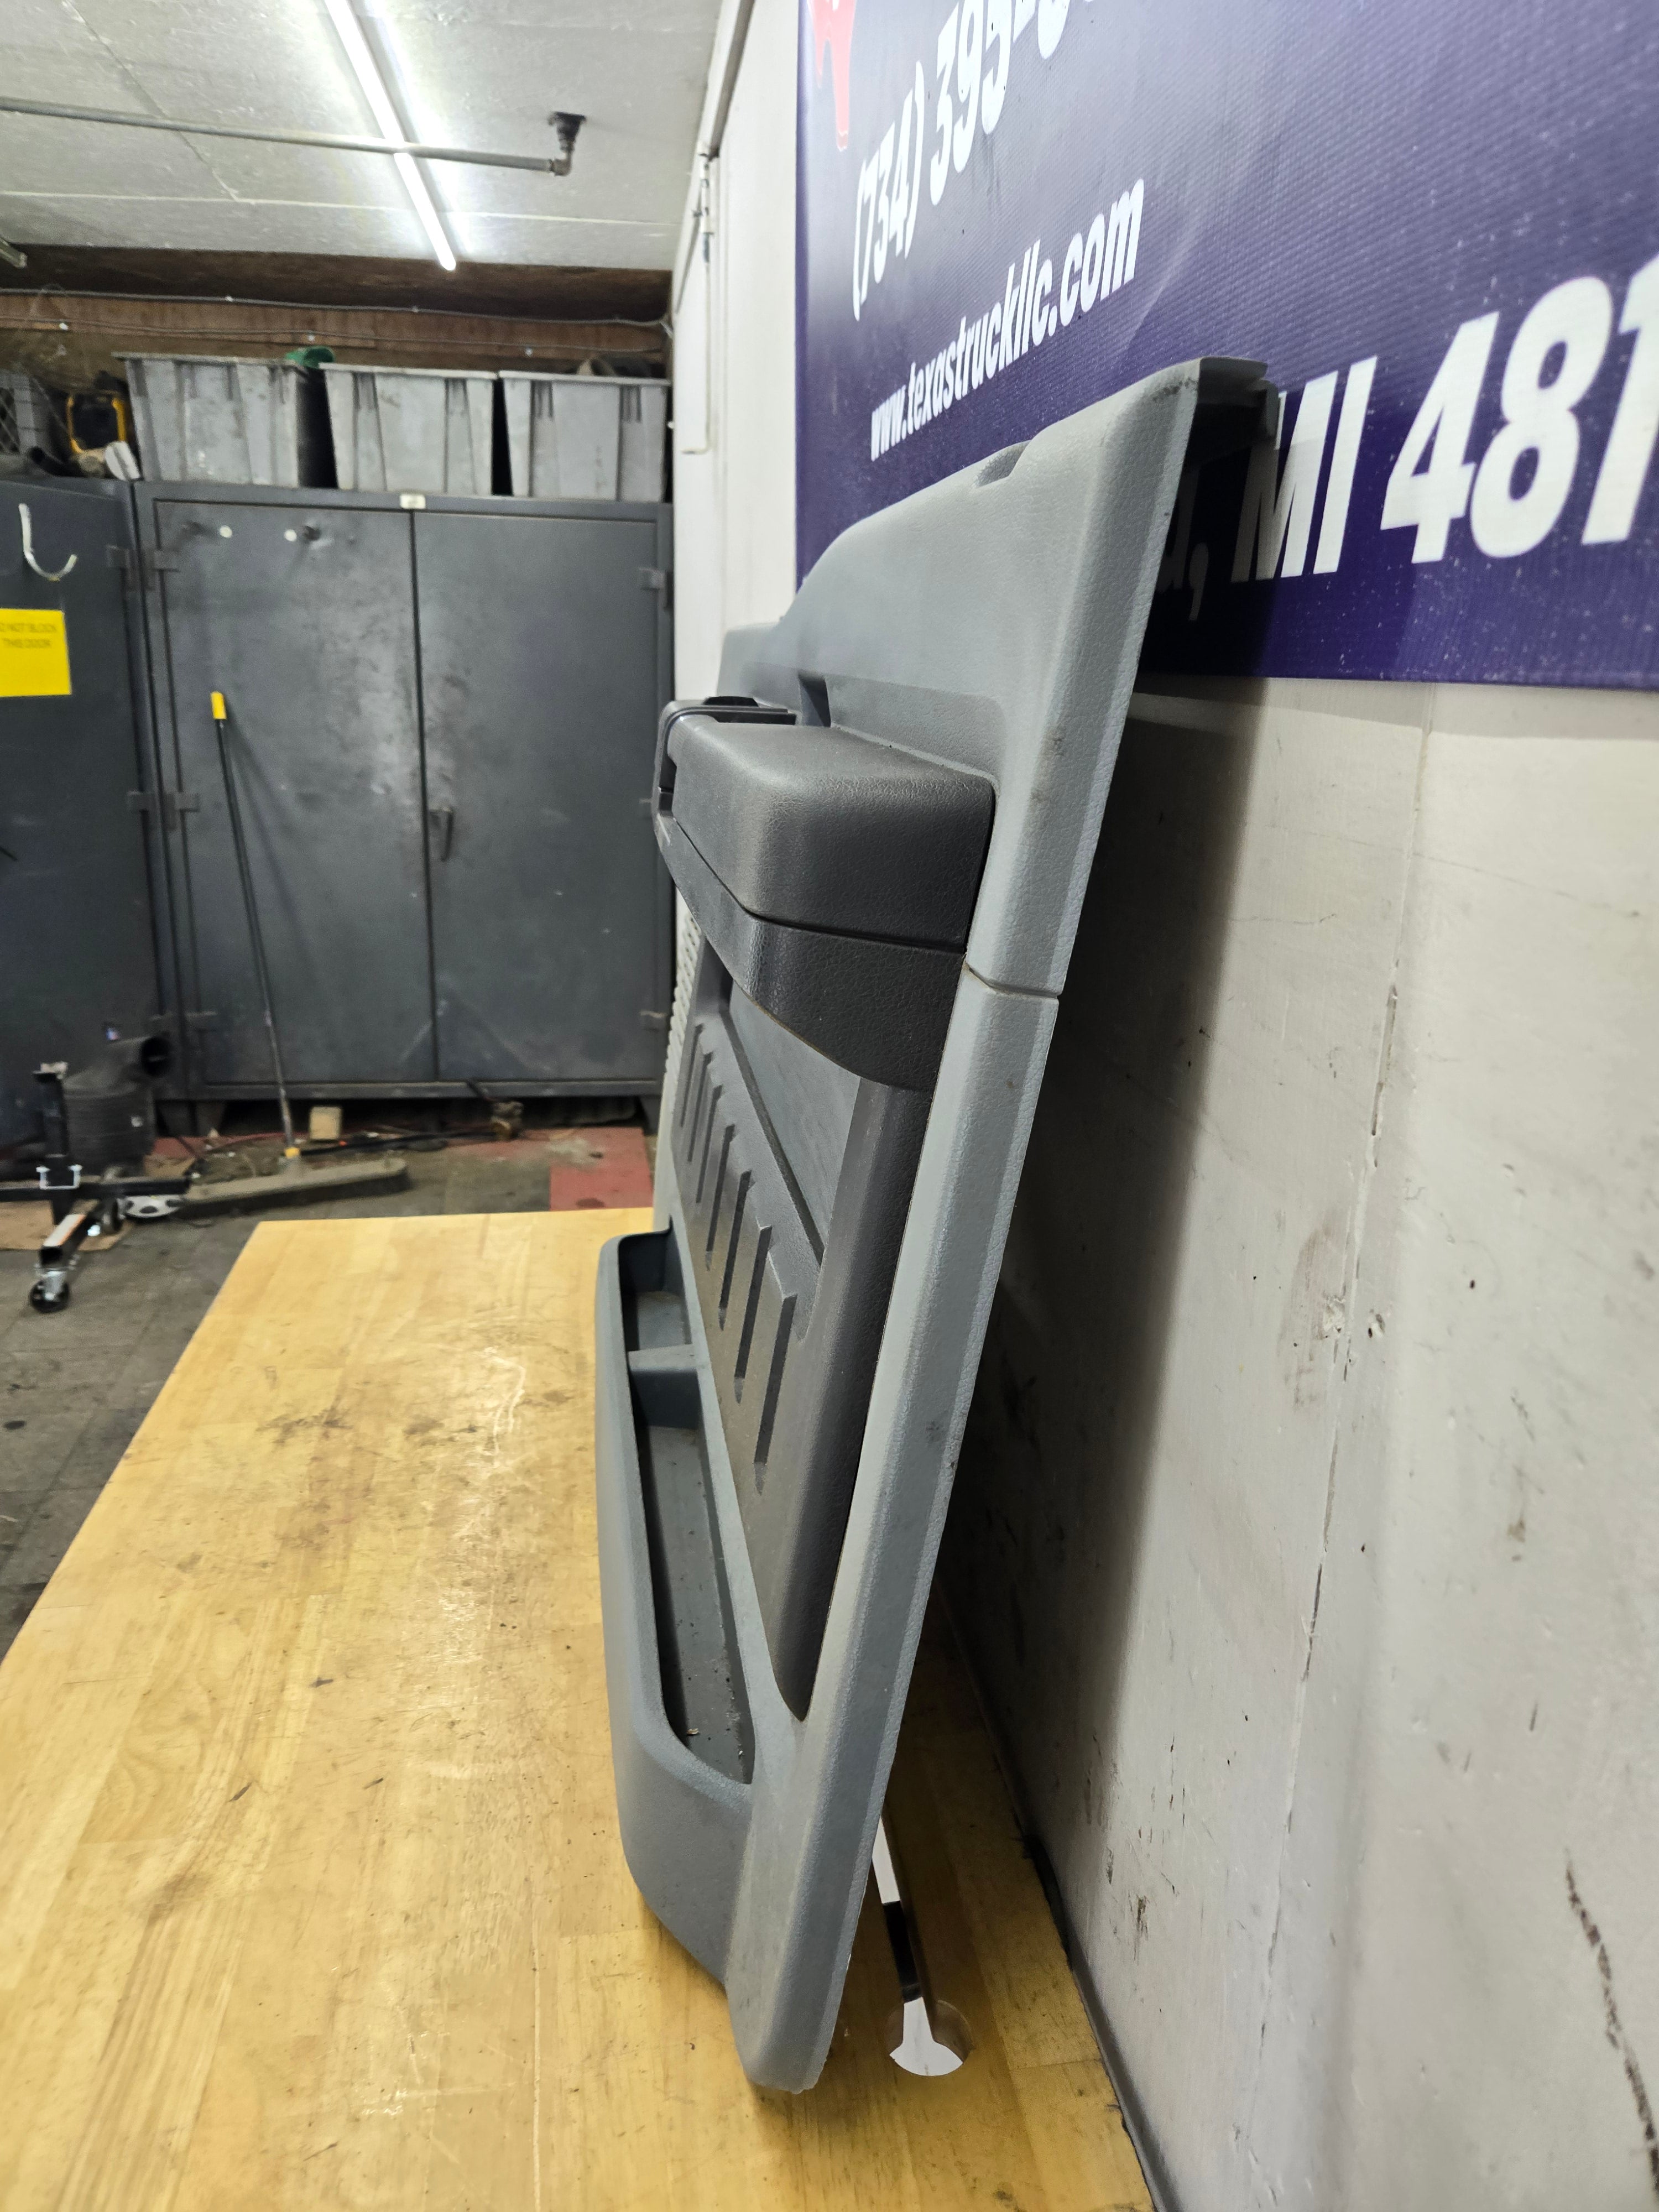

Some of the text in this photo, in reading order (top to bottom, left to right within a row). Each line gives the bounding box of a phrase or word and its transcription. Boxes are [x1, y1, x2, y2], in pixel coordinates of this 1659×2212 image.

[853, 60, 925, 321] (734)
[871, 179, 1144, 461] www.texastruckllc.com
[1231, 356, 1378, 583] MI
